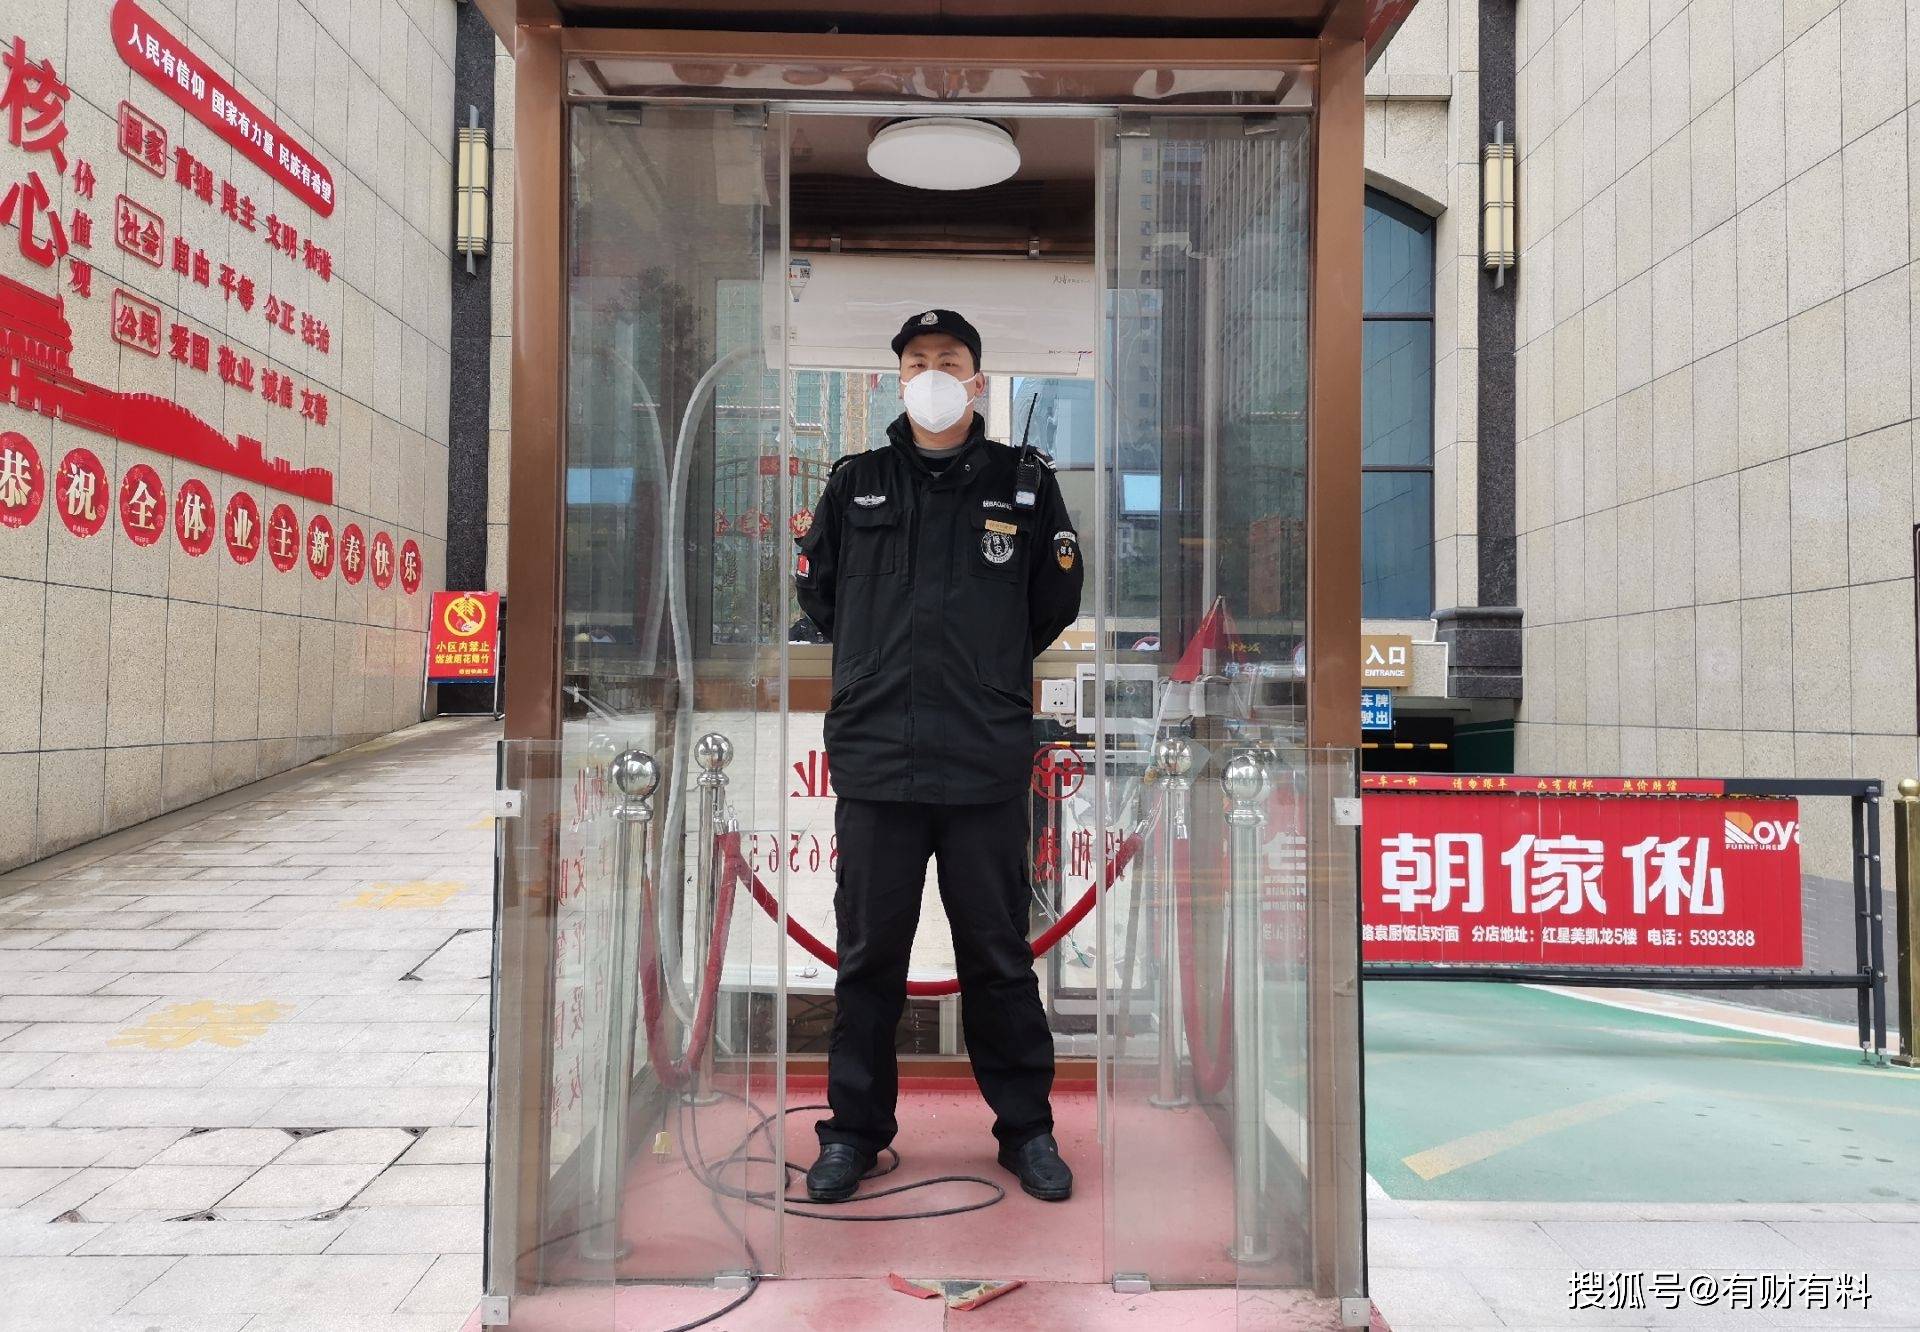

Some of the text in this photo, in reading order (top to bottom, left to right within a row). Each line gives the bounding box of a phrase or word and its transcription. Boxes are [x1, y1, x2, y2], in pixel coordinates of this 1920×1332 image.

[128, 23, 332, 204] 人民有信仰 国家有力量 民族有希望
[70, 158, 97, 298] 价值观
[120, 205, 160, 257] 社会
[265, 213, 297, 260] 文明
[172, 236, 210, 288] 自由
[264, 292, 296, 335] 公正
[117, 304, 158, 348] 公民
[169, 323, 210, 373] 爱国
[435, 641, 490, 653] 小区内禁止
[1365, 644, 1406, 665] 入口
[1364, 668, 1406, 677] ENTRANCE
[1381, 832, 1725, 915] 朝傢俬
